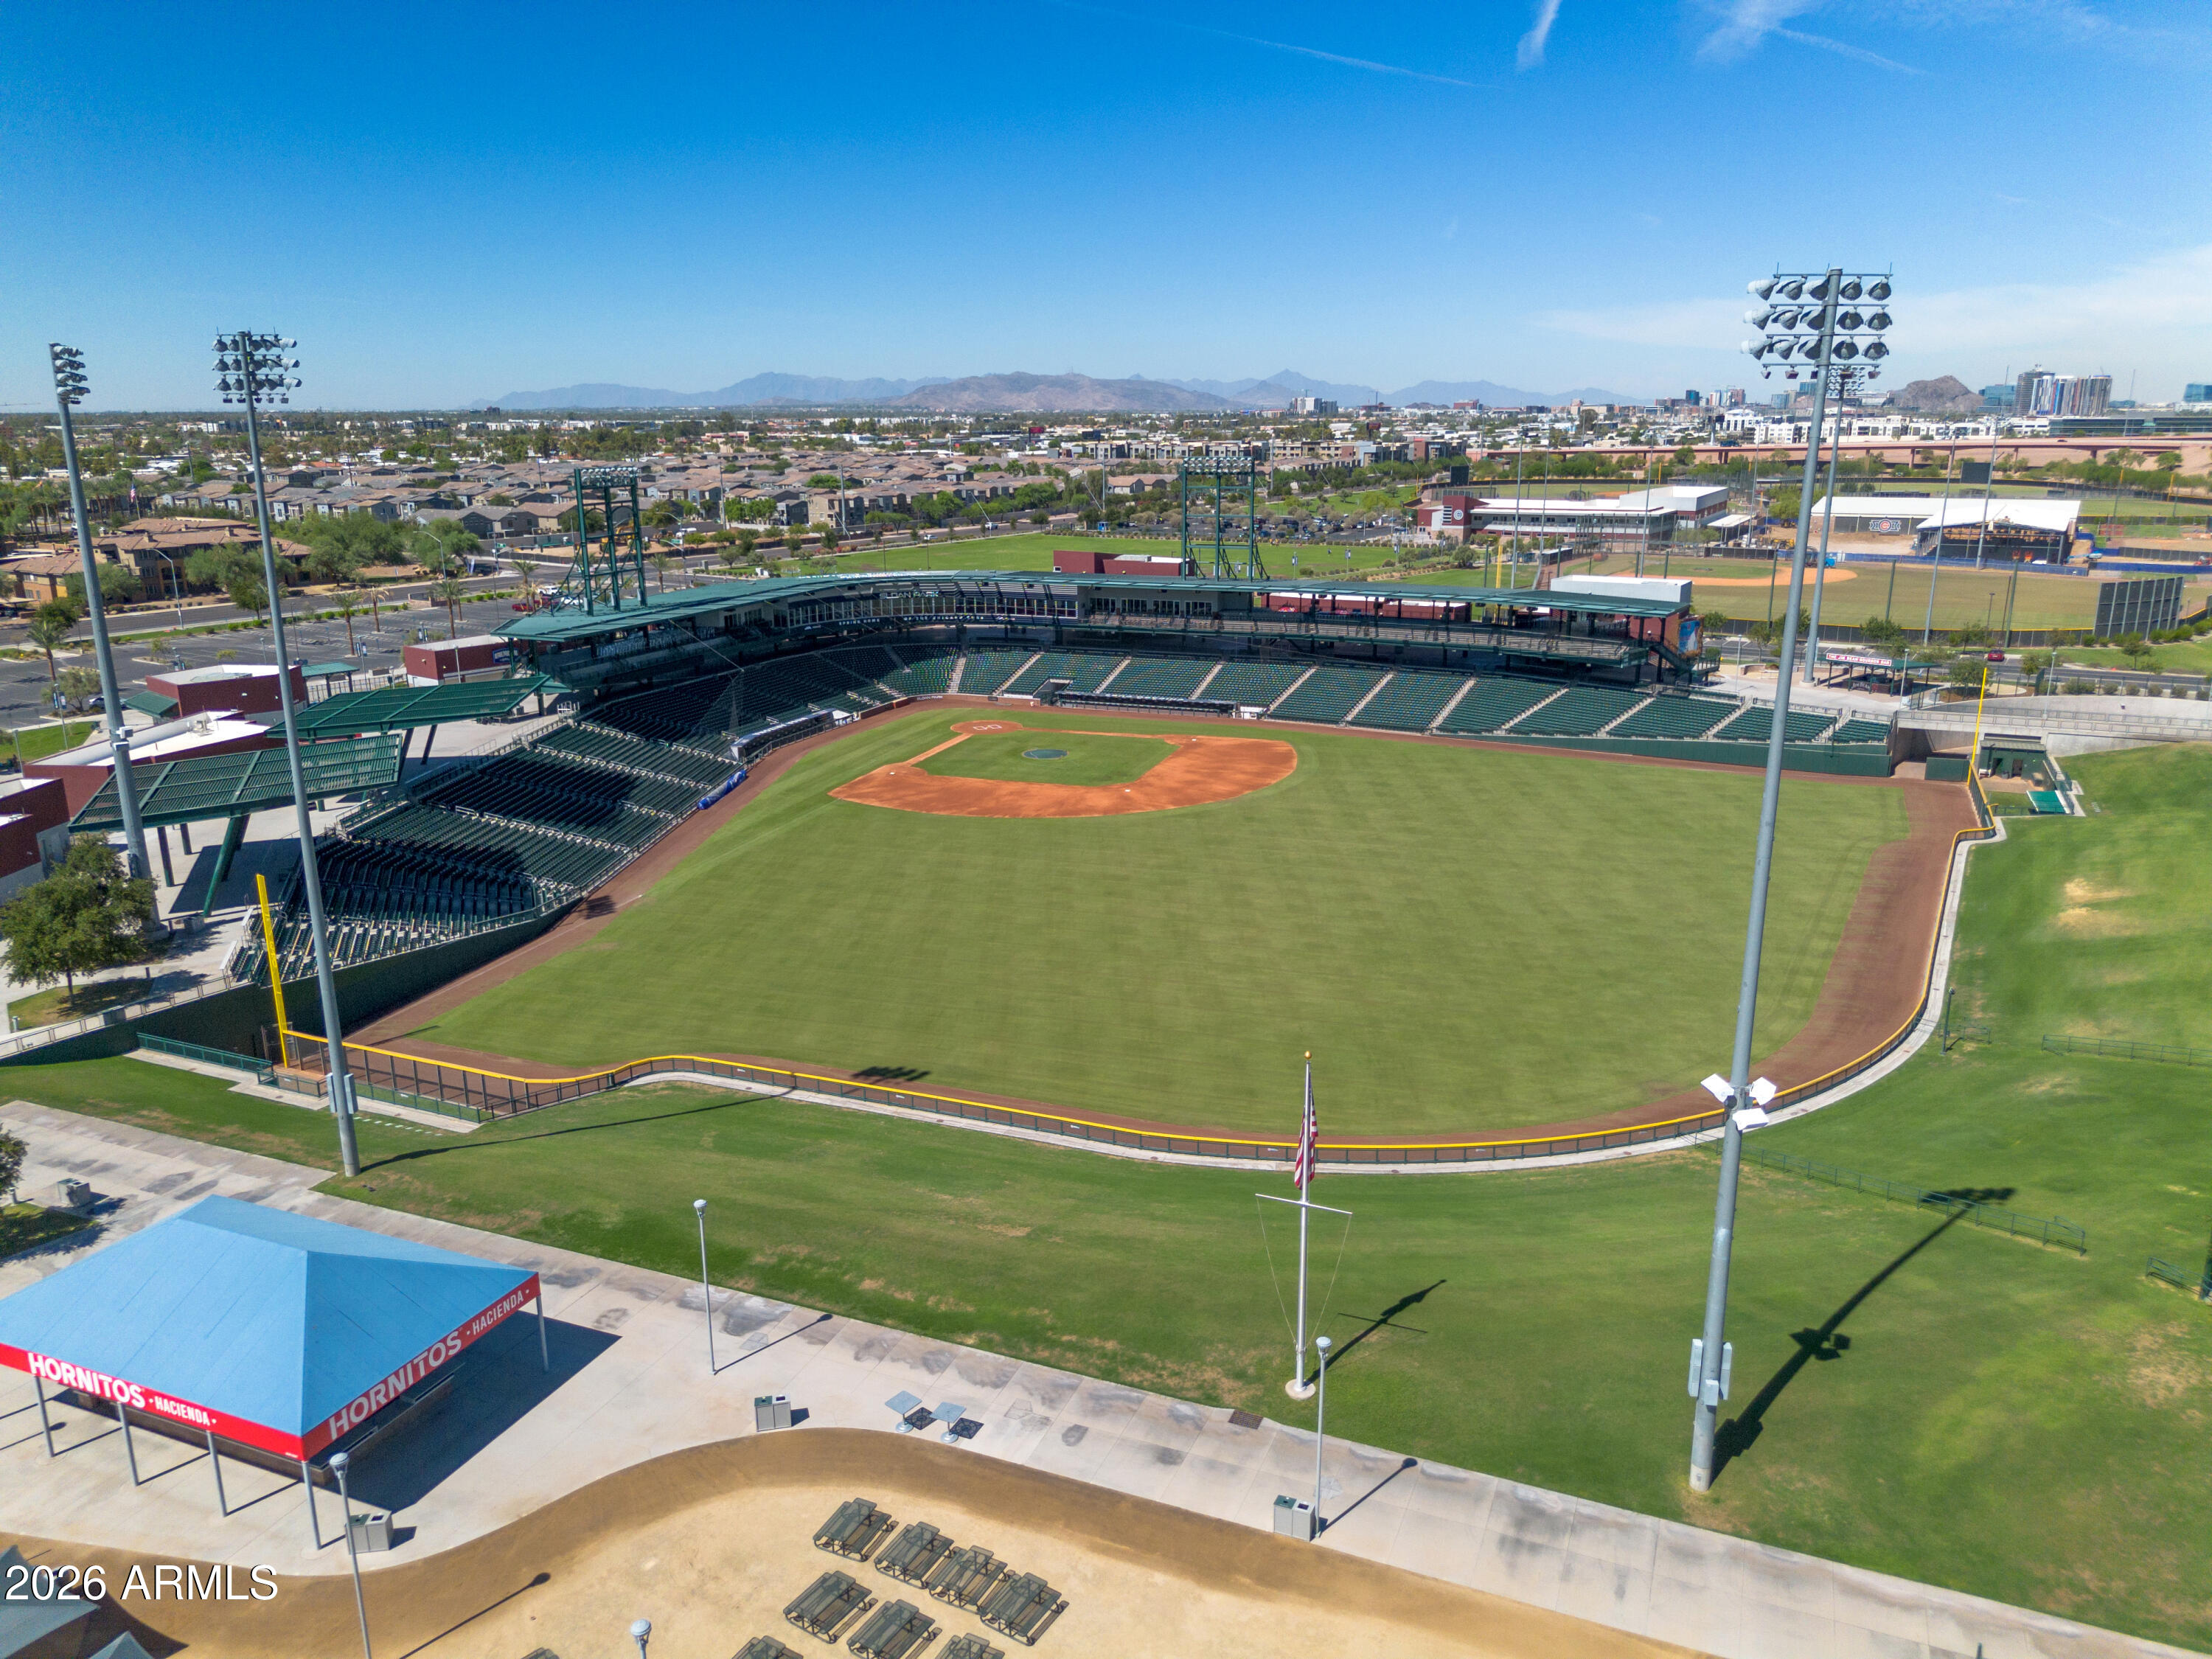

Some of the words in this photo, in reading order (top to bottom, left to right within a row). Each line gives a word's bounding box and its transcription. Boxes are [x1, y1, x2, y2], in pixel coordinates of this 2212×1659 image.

[879, 591, 911, 599] SLOAN
[27, 1352, 146, 1408] HORNITOS
[155, 1396, 211, 1426] HACIENDA
[329, 1329, 462, 1440] HORNITOS
[473, 1290, 524, 1335] HACIENDA
